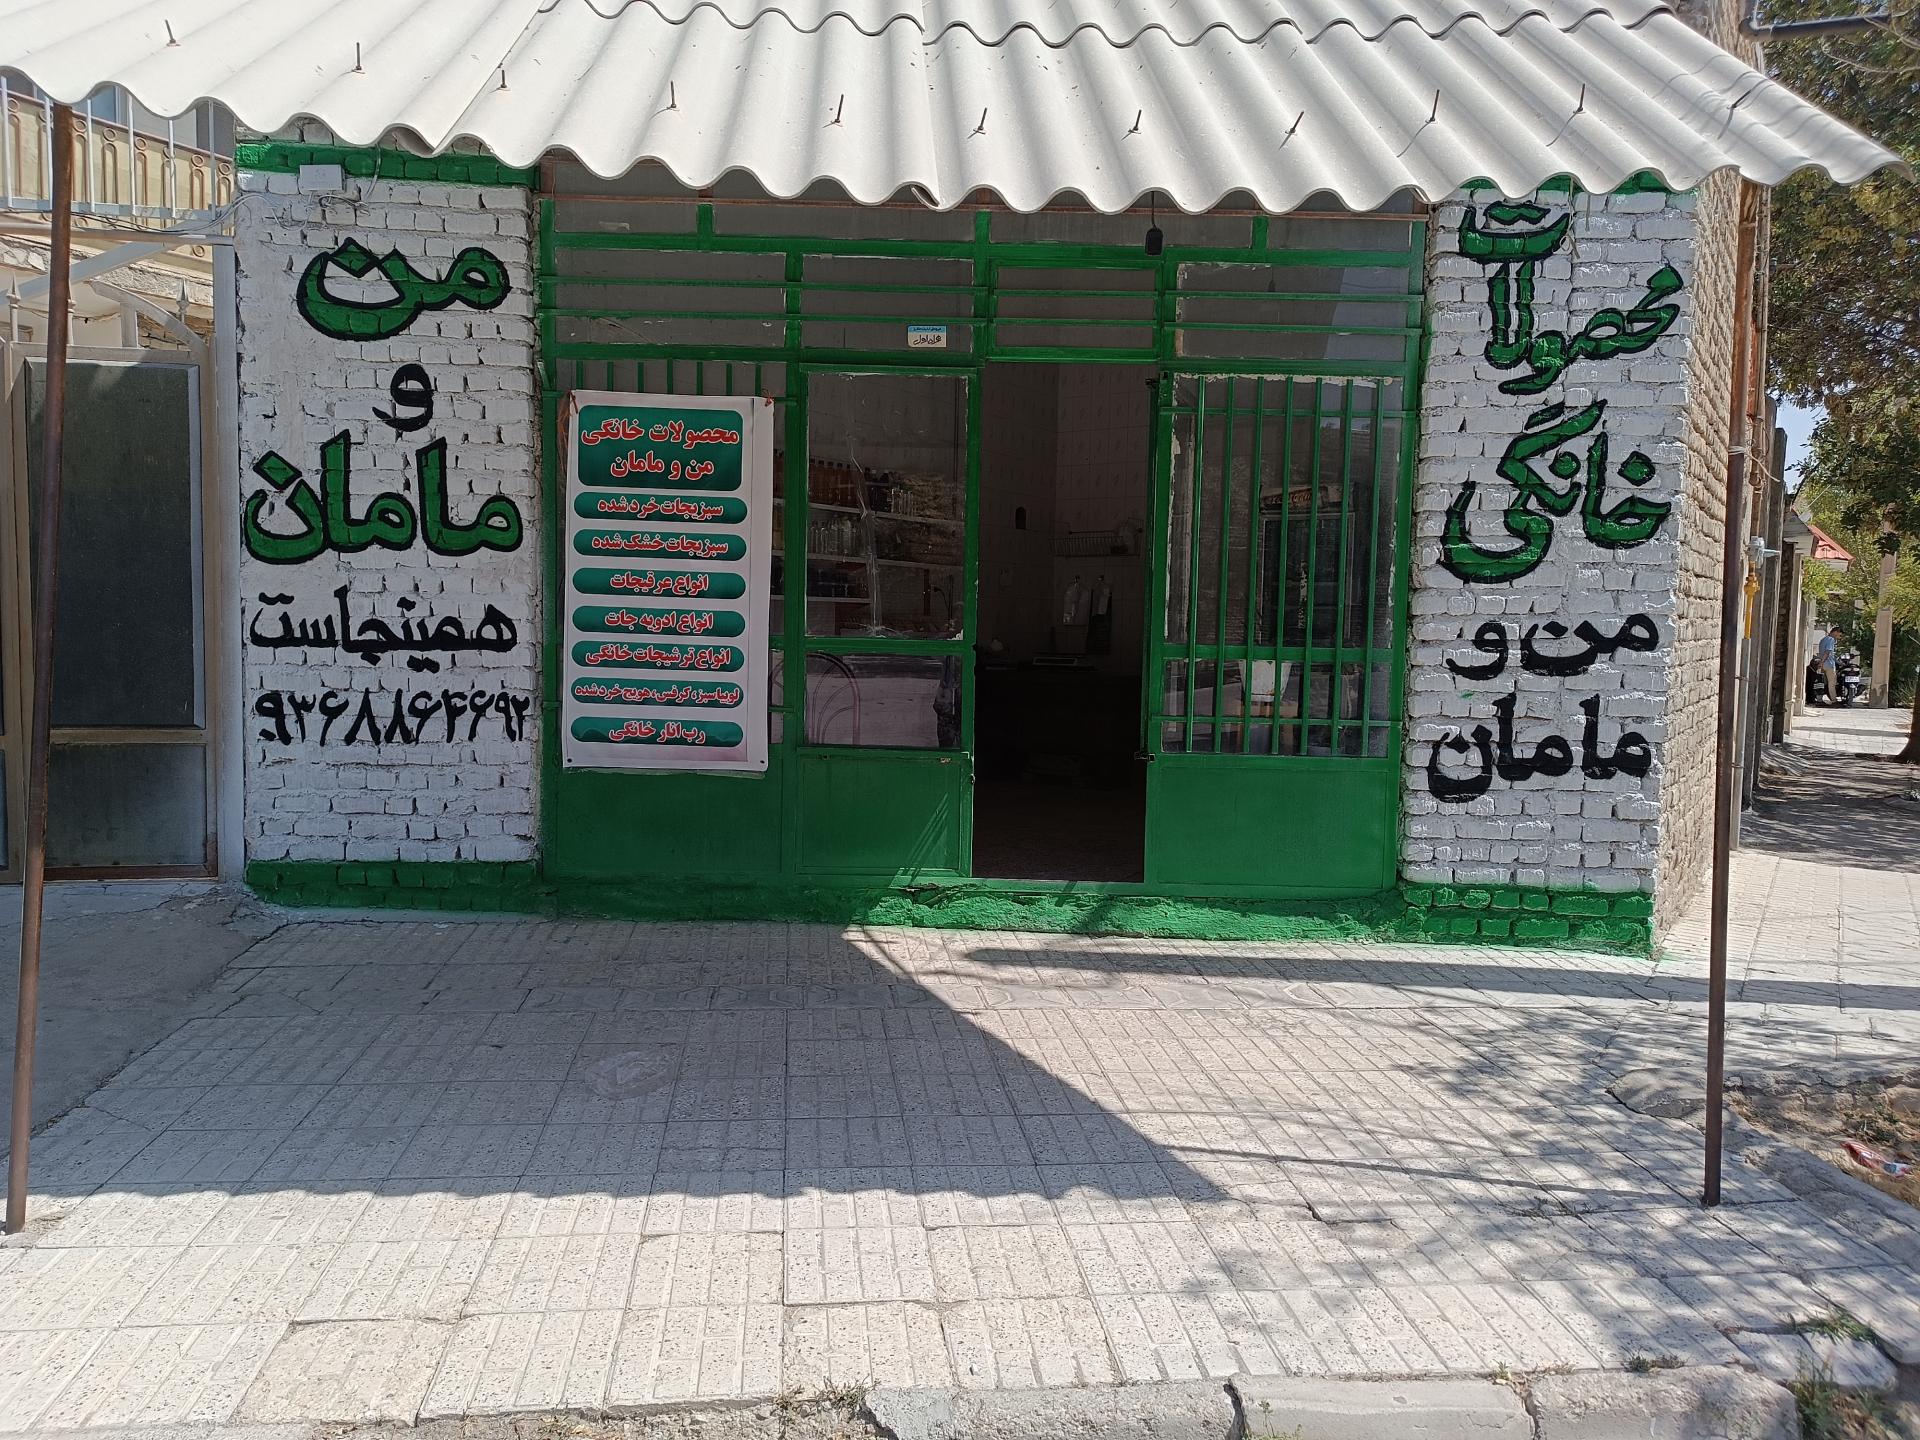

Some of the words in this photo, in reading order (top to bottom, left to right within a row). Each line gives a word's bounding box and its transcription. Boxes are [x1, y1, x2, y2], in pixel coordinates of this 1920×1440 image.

[297, 236, 511, 341] من
[1458, 201, 1685, 395] محصولات
[372, 363, 434, 431] و
[581, 418, 644, 446] خانگی
[649, 420, 739, 448] محصولات
[610, 451, 664, 477] مامان
[668, 460, 681, 479] و
[685, 459, 714, 479] من
[244, 430, 523, 565] مامان
[1440, 399, 1671, 584] خانگی
[598, 496, 628, 512] شده
[661, 498, 723, 520] سبزیجات
[592, 533, 622, 549] شده
[623, 534, 665, 550] خشک
[665, 535, 728, 557] سبزیجات
[610, 571, 672, 594] عرقیجات
[672, 574, 709, 595] انواع
[249, 585, 518, 673] همینجاست
[677, 612, 713, 634] انواع
[586, 644, 632, 664] خانگی
[634, 645, 694, 667] ترشیجات
[1445, 615, 1506, 680] و
[1521, 613, 1659, 677] من
[695, 647, 730, 668] انواع
[609, 721, 655, 741] خانگی
[657, 722, 682, 742] انار
[682, 728, 706, 743] رب
[1428, 694, 1652, 802] مامان
